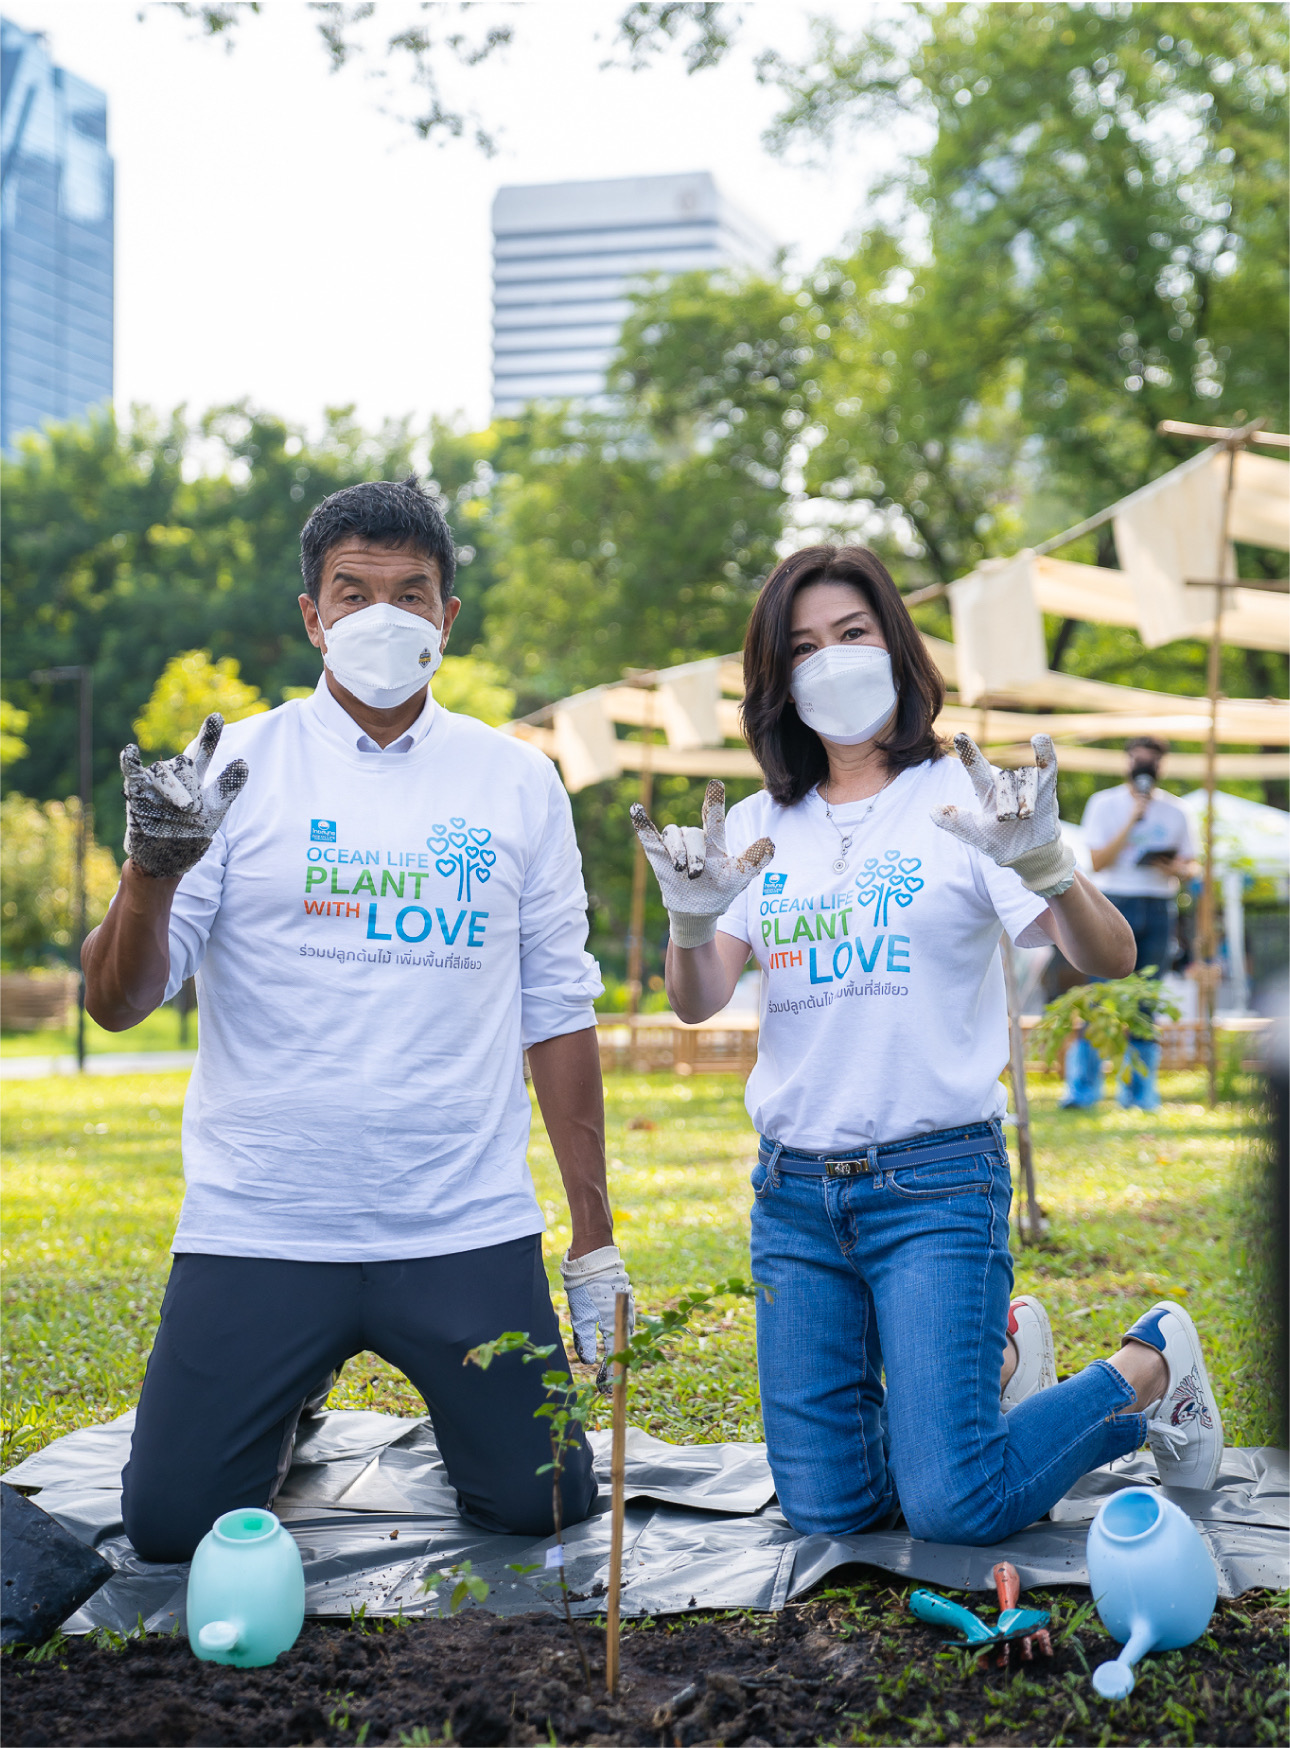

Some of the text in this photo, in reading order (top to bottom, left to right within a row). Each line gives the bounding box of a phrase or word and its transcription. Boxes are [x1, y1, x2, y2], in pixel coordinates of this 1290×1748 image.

[306, 847, 429, 868] OCEAN LIFE
[305, 866, 430, 900] PLANT
[303, 900, 361, 919] WITH
[760, 890, 854, 917] OCEAN LIFE
[366, 902, 490, 948] LOVE
[761, 907, 853, 948] PLANT
[299, 943, 482, 970] ร่วมปลูกต้นไม้ เพิ่มพื้นที่สีเขียว
[808, 935, 911, 985] LOVE
